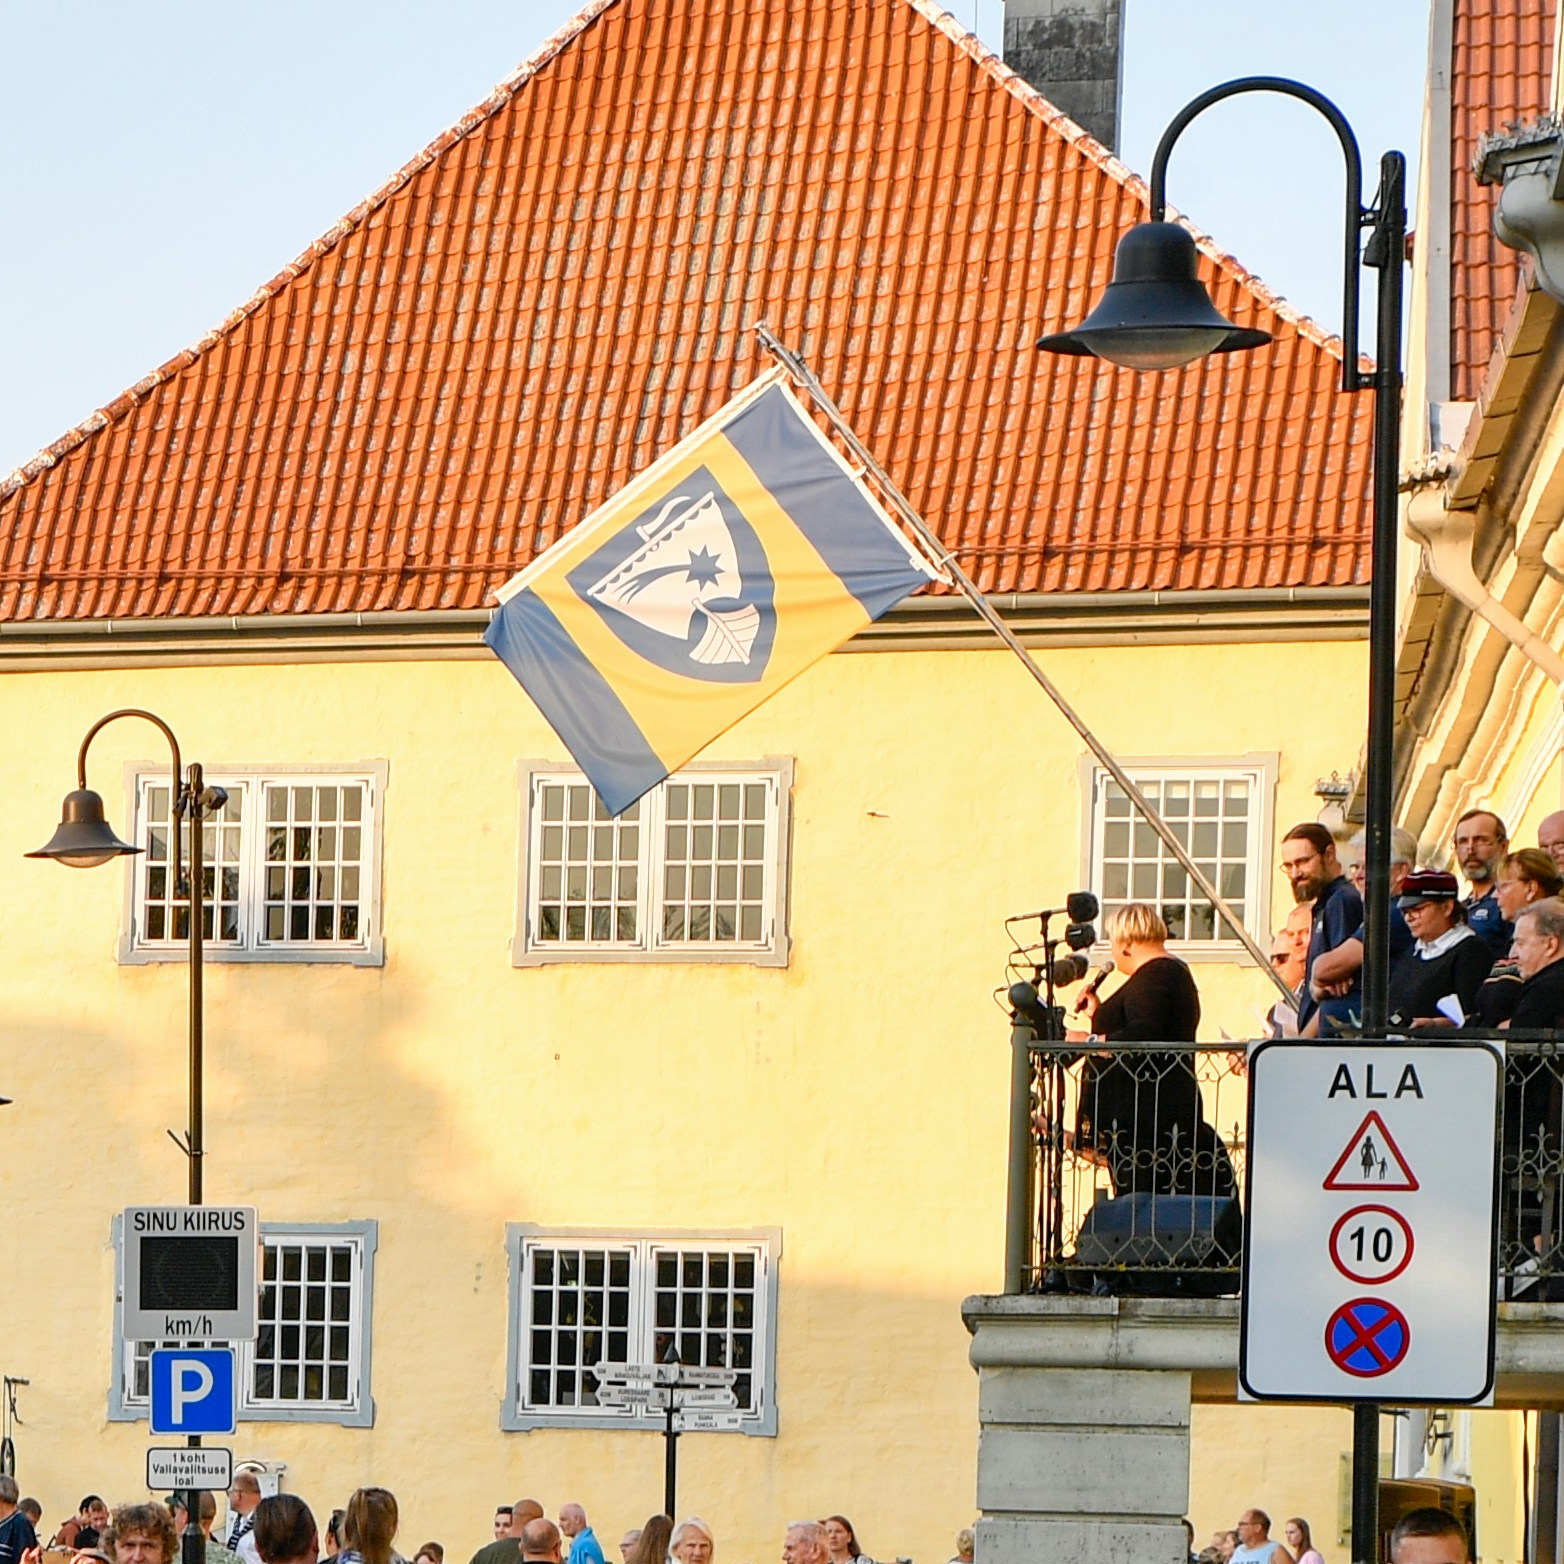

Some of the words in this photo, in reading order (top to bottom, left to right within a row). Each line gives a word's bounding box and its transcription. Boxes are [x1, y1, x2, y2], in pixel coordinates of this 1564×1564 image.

[1328, 1064, 1424, 1099] ALA
[134, 1211, 177, 1231] SINU
[184, 1211, 245, 1231] KIIRUS
[1350, 1226, 1393, 1262] 10
[165, 1315, 213, 1335] km/h
[171, 1359, 214, 1424] P
[172, 1453, 177, 1463] 1
[180, 1453, 206, 1463] koht
[152, 1463, 226, 1474] Vallavalitsuse
[174, 1476, 194, 1486] loal
